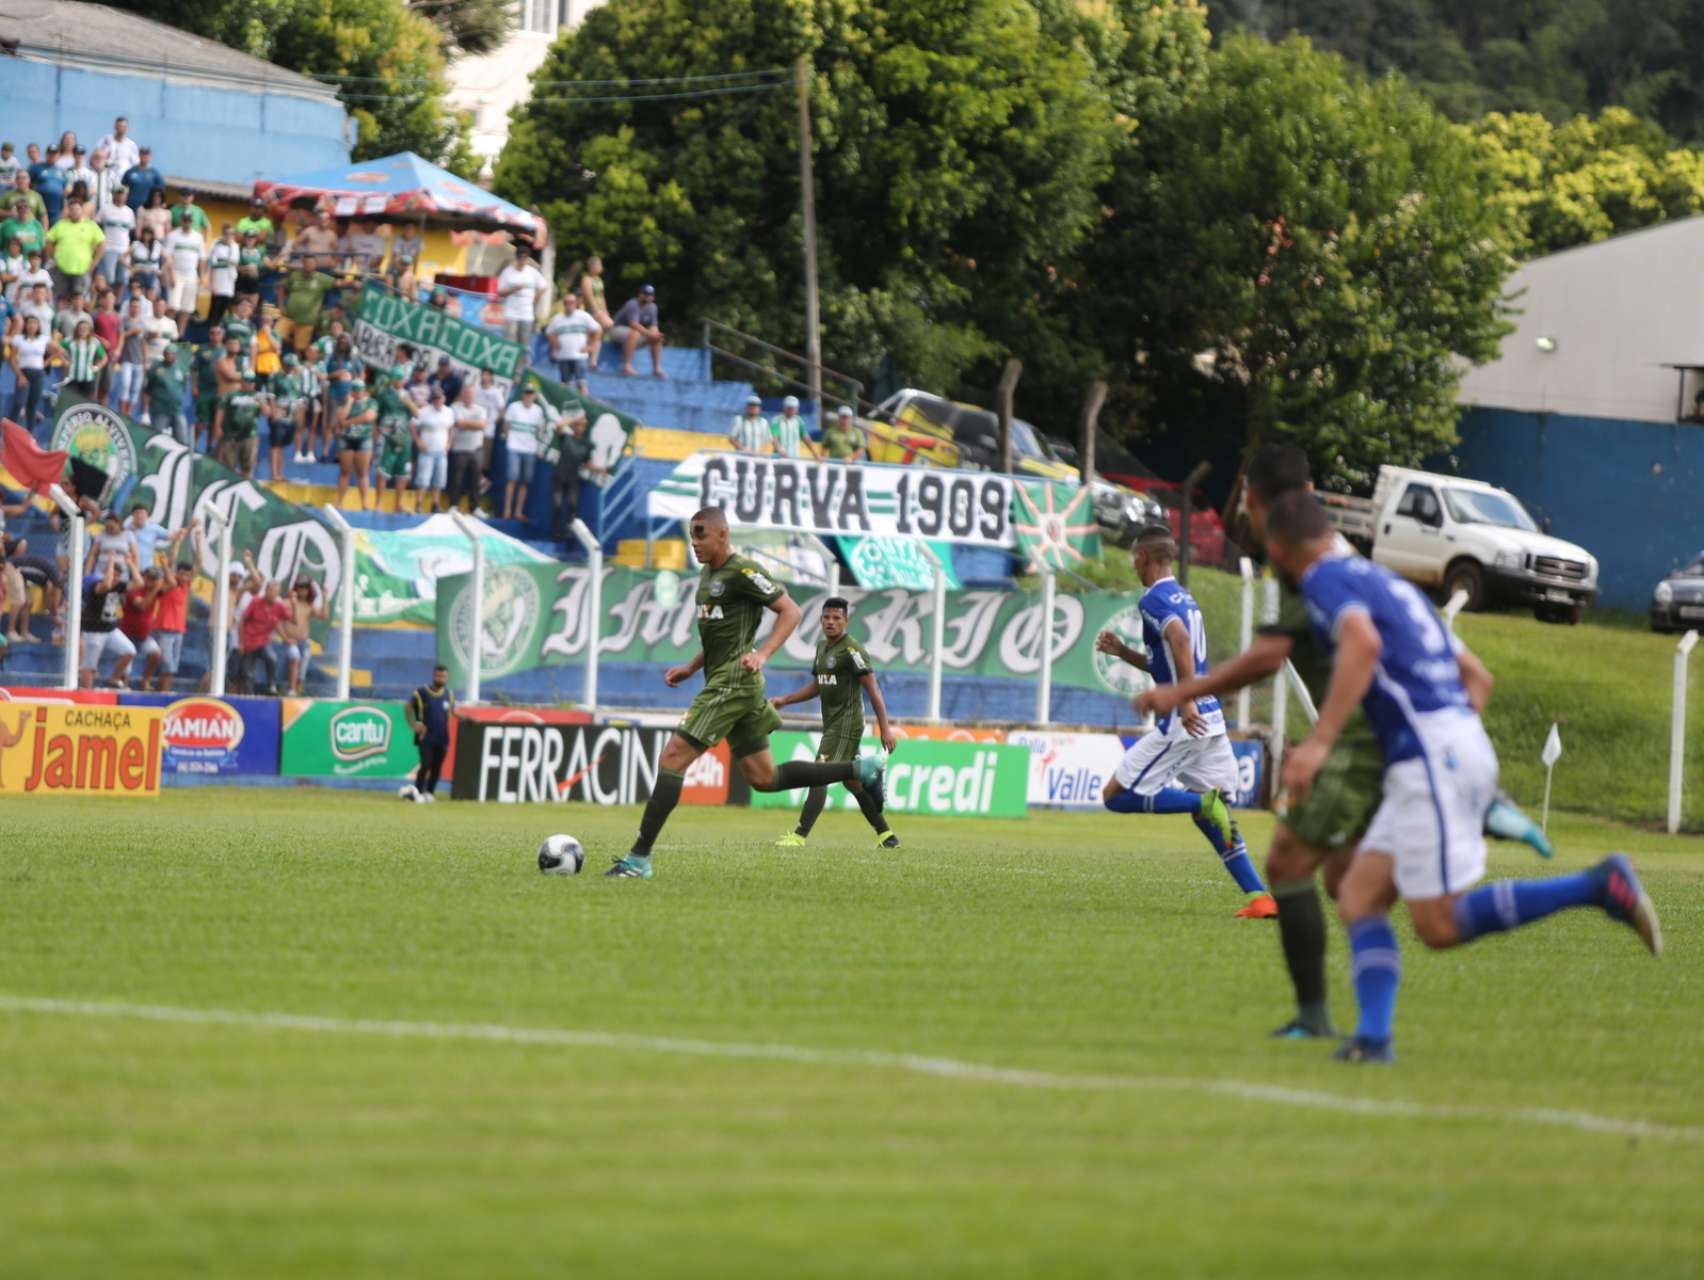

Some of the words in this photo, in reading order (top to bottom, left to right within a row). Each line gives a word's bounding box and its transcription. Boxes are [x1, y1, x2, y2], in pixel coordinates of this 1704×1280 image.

[701, 459, 871, 532] CURVA
[897, 473, 1006, 540] 1909
[65, 710, 131, 731] CACHAÇA
[336, 718, 385, 743] cantu
[25, 706, 160, 792] jamel
[1049, 768, 1101, 801] Valle
